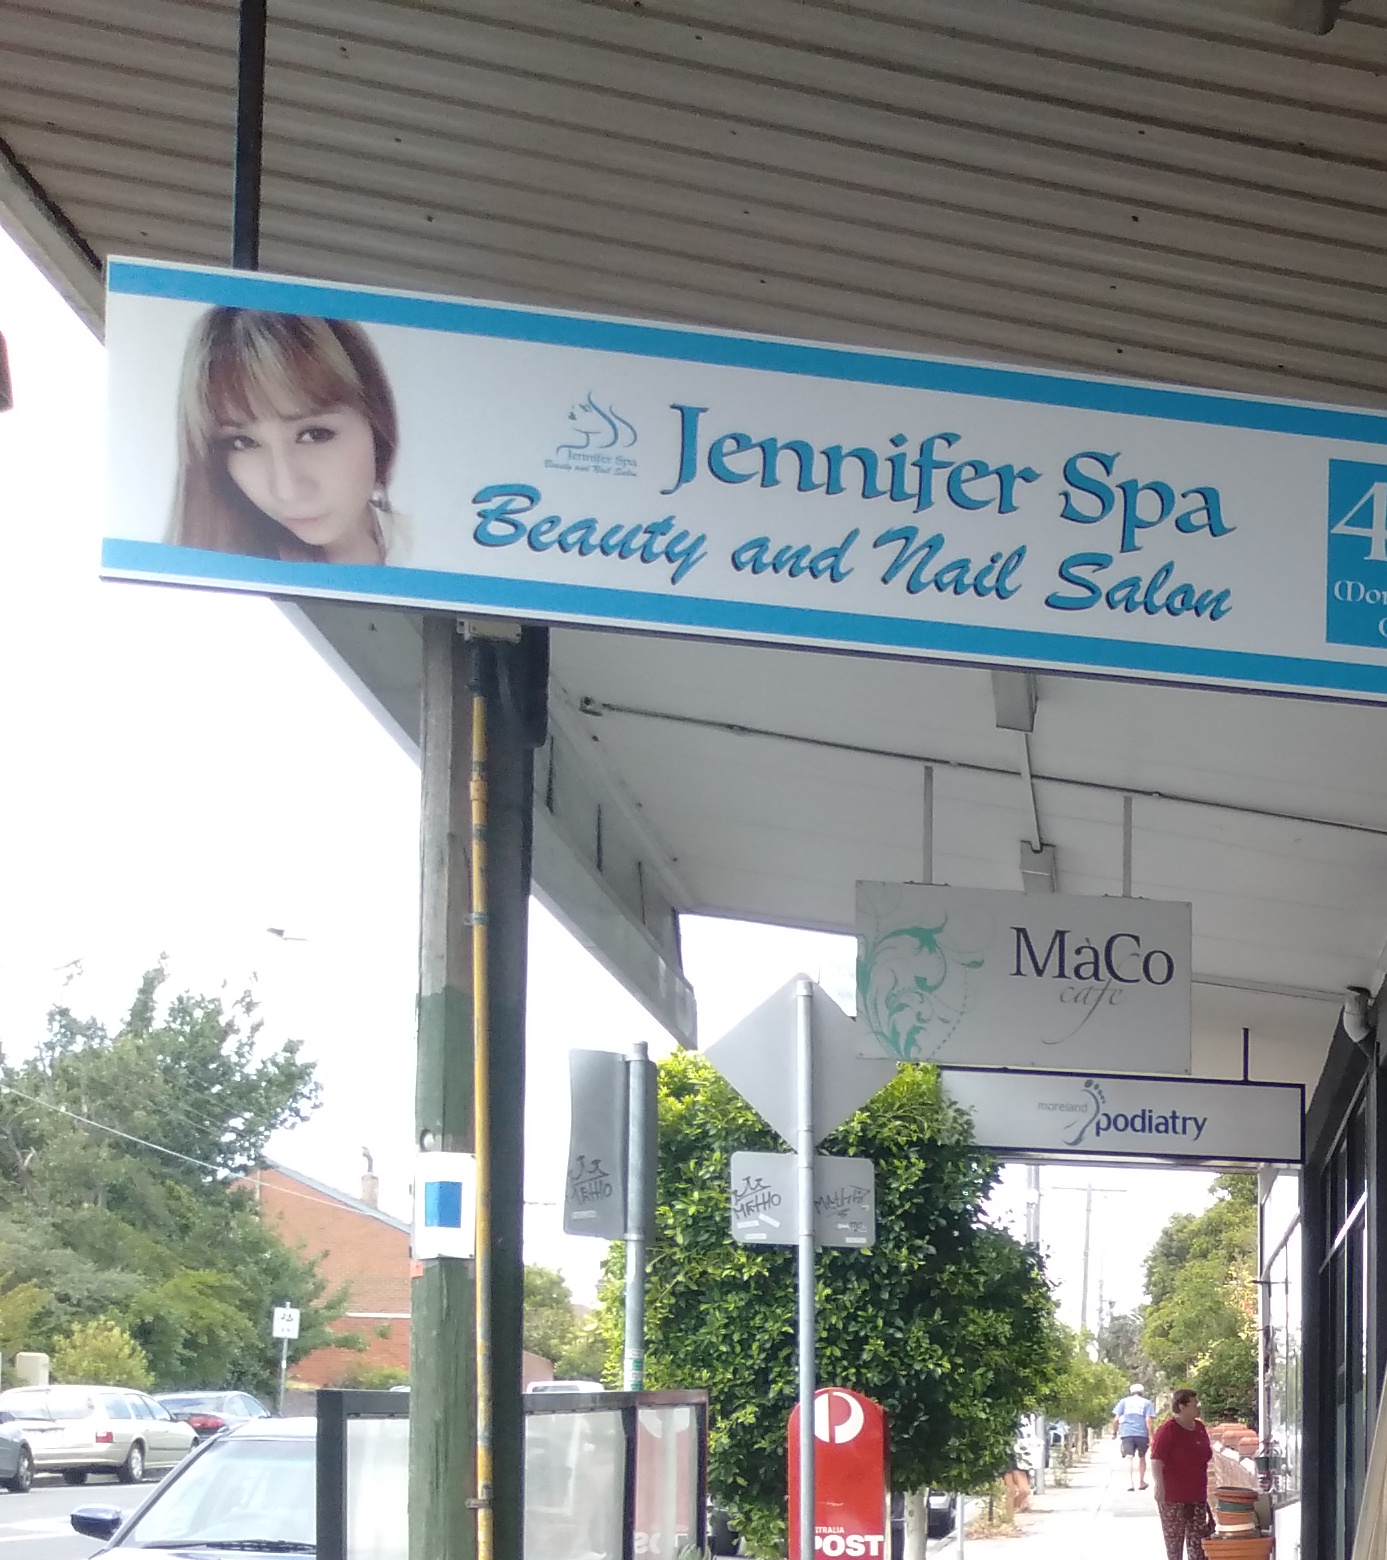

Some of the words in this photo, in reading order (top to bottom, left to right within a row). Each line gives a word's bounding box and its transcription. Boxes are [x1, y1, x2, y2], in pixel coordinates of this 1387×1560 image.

[660, 403, 1044, 515] Jennifer
[1058, 451, 1237, 554] Spa
[472, 483, 708, 586] Beauty
[731, 528, 860, 584] and
[873, 525, 1027, 601] Nail
[1045, 552, 1233, 622] Salon
[1037, 1101, 1088, 1113] moreland
[1095, 1109, 1207, 1142] podiatry
